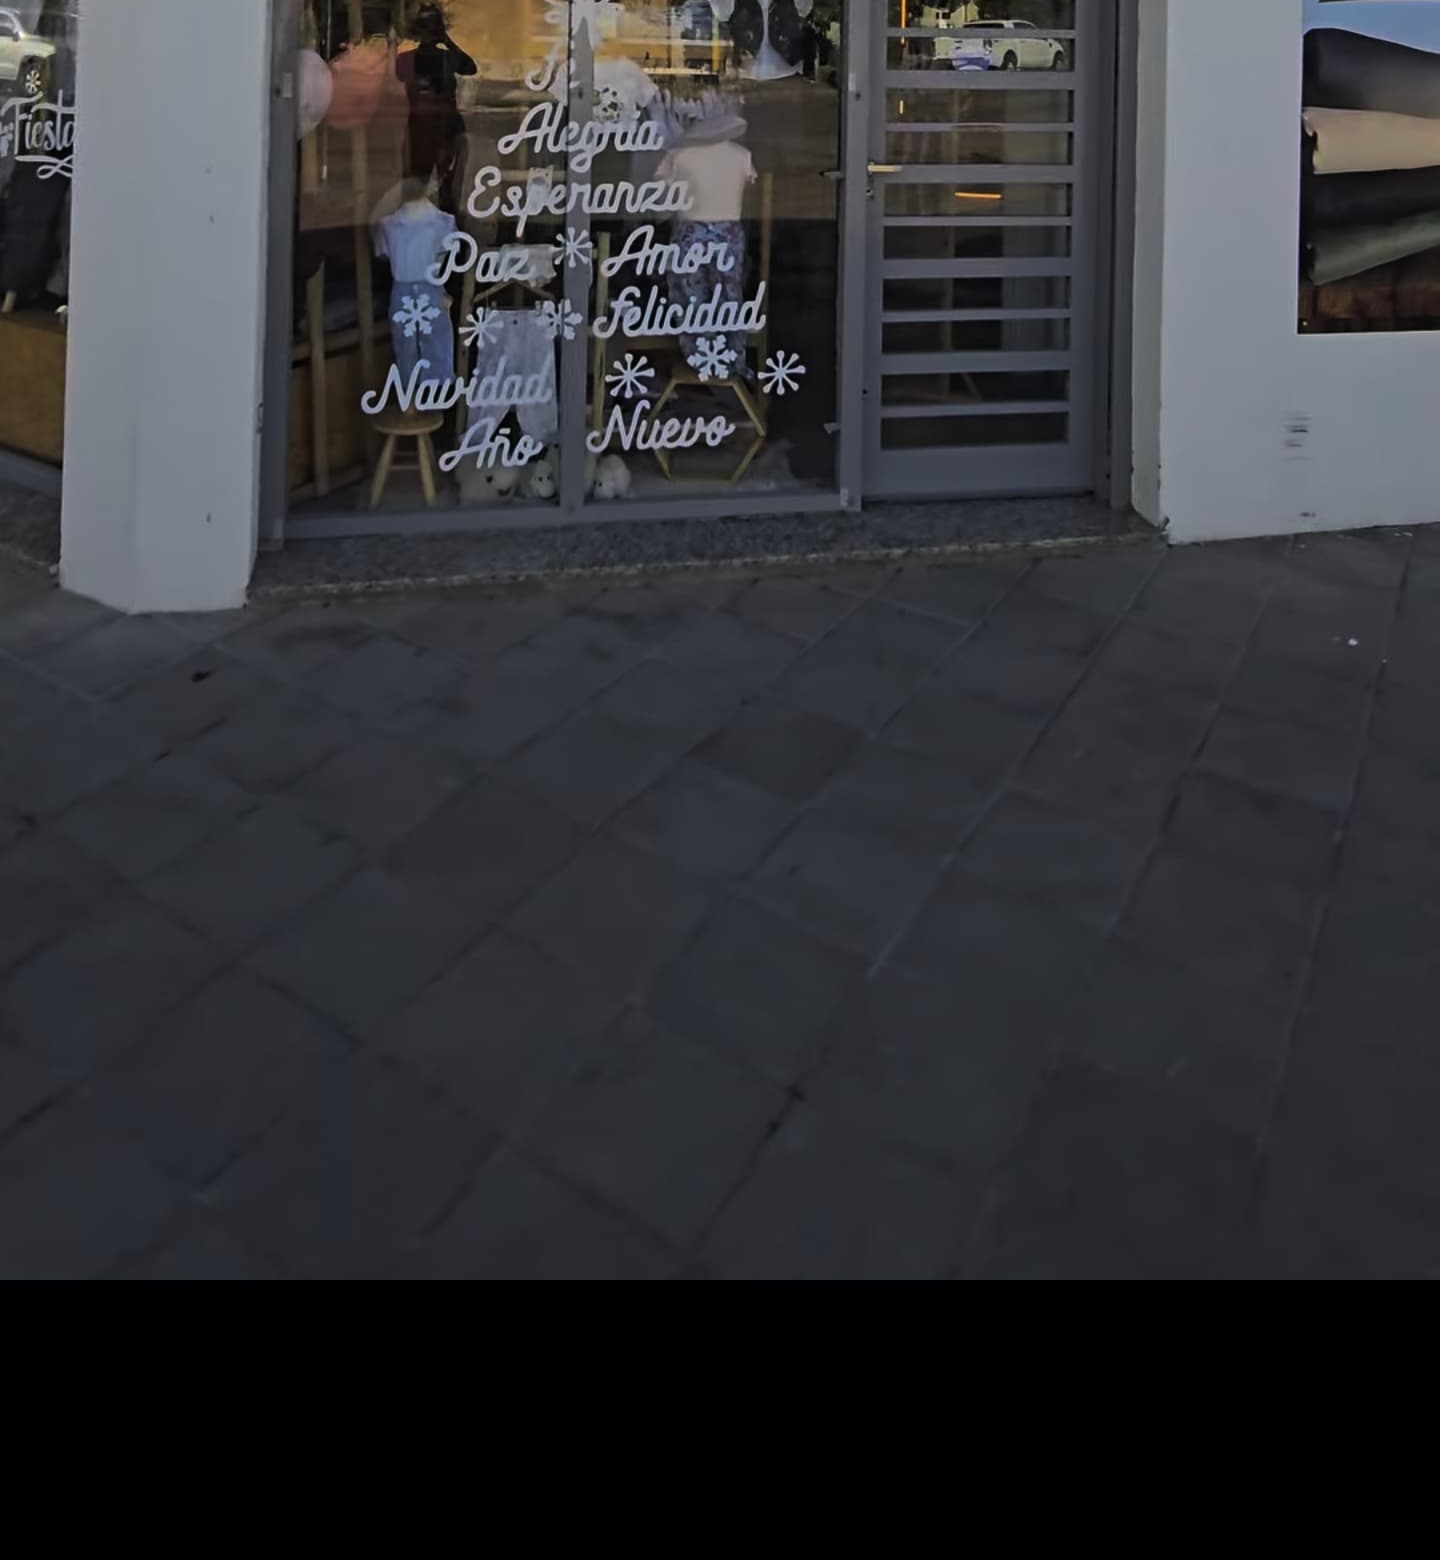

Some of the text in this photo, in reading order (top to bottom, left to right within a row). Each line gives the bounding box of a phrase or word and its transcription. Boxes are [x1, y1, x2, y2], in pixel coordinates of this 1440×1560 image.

[467, 166, 695, 238] Esperanza
[427, 224, 736, 286] Paz Amor
[362, 357, 553, 414] Navidad
[438, 399, 736, 472] Año Nuevo
